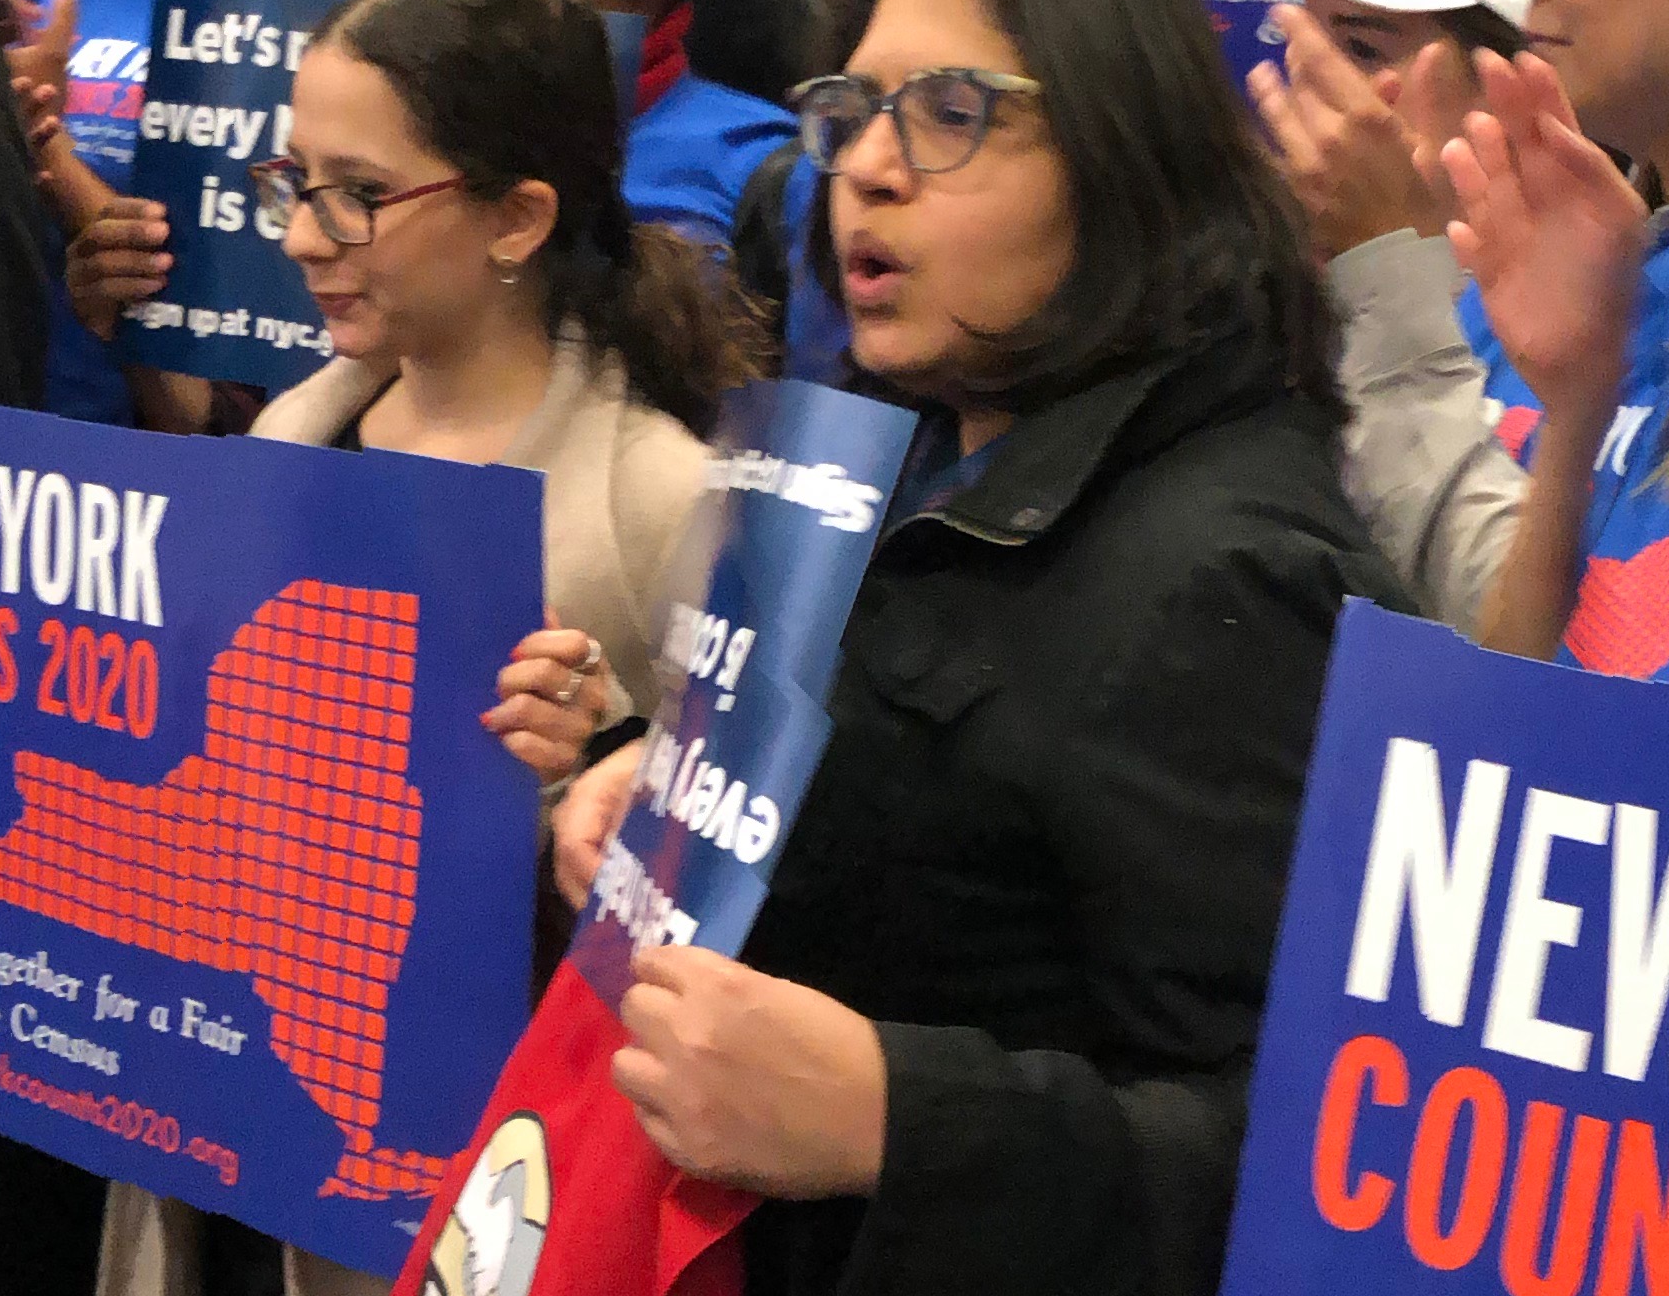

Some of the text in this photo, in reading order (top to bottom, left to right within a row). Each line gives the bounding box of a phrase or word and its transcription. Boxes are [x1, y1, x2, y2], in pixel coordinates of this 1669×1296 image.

[163, 8, 283, 68] Let's
[140, 101, 269, 160] every
[199, 175, 246, 233] is
[37, 619, 159, 740] 2020
[10, 1003, 120, 1077] Census
[93, 973, 141, 1021] for
[149, 1005, 171, 1032] a
[180, 997, 249, 1055] Fair
